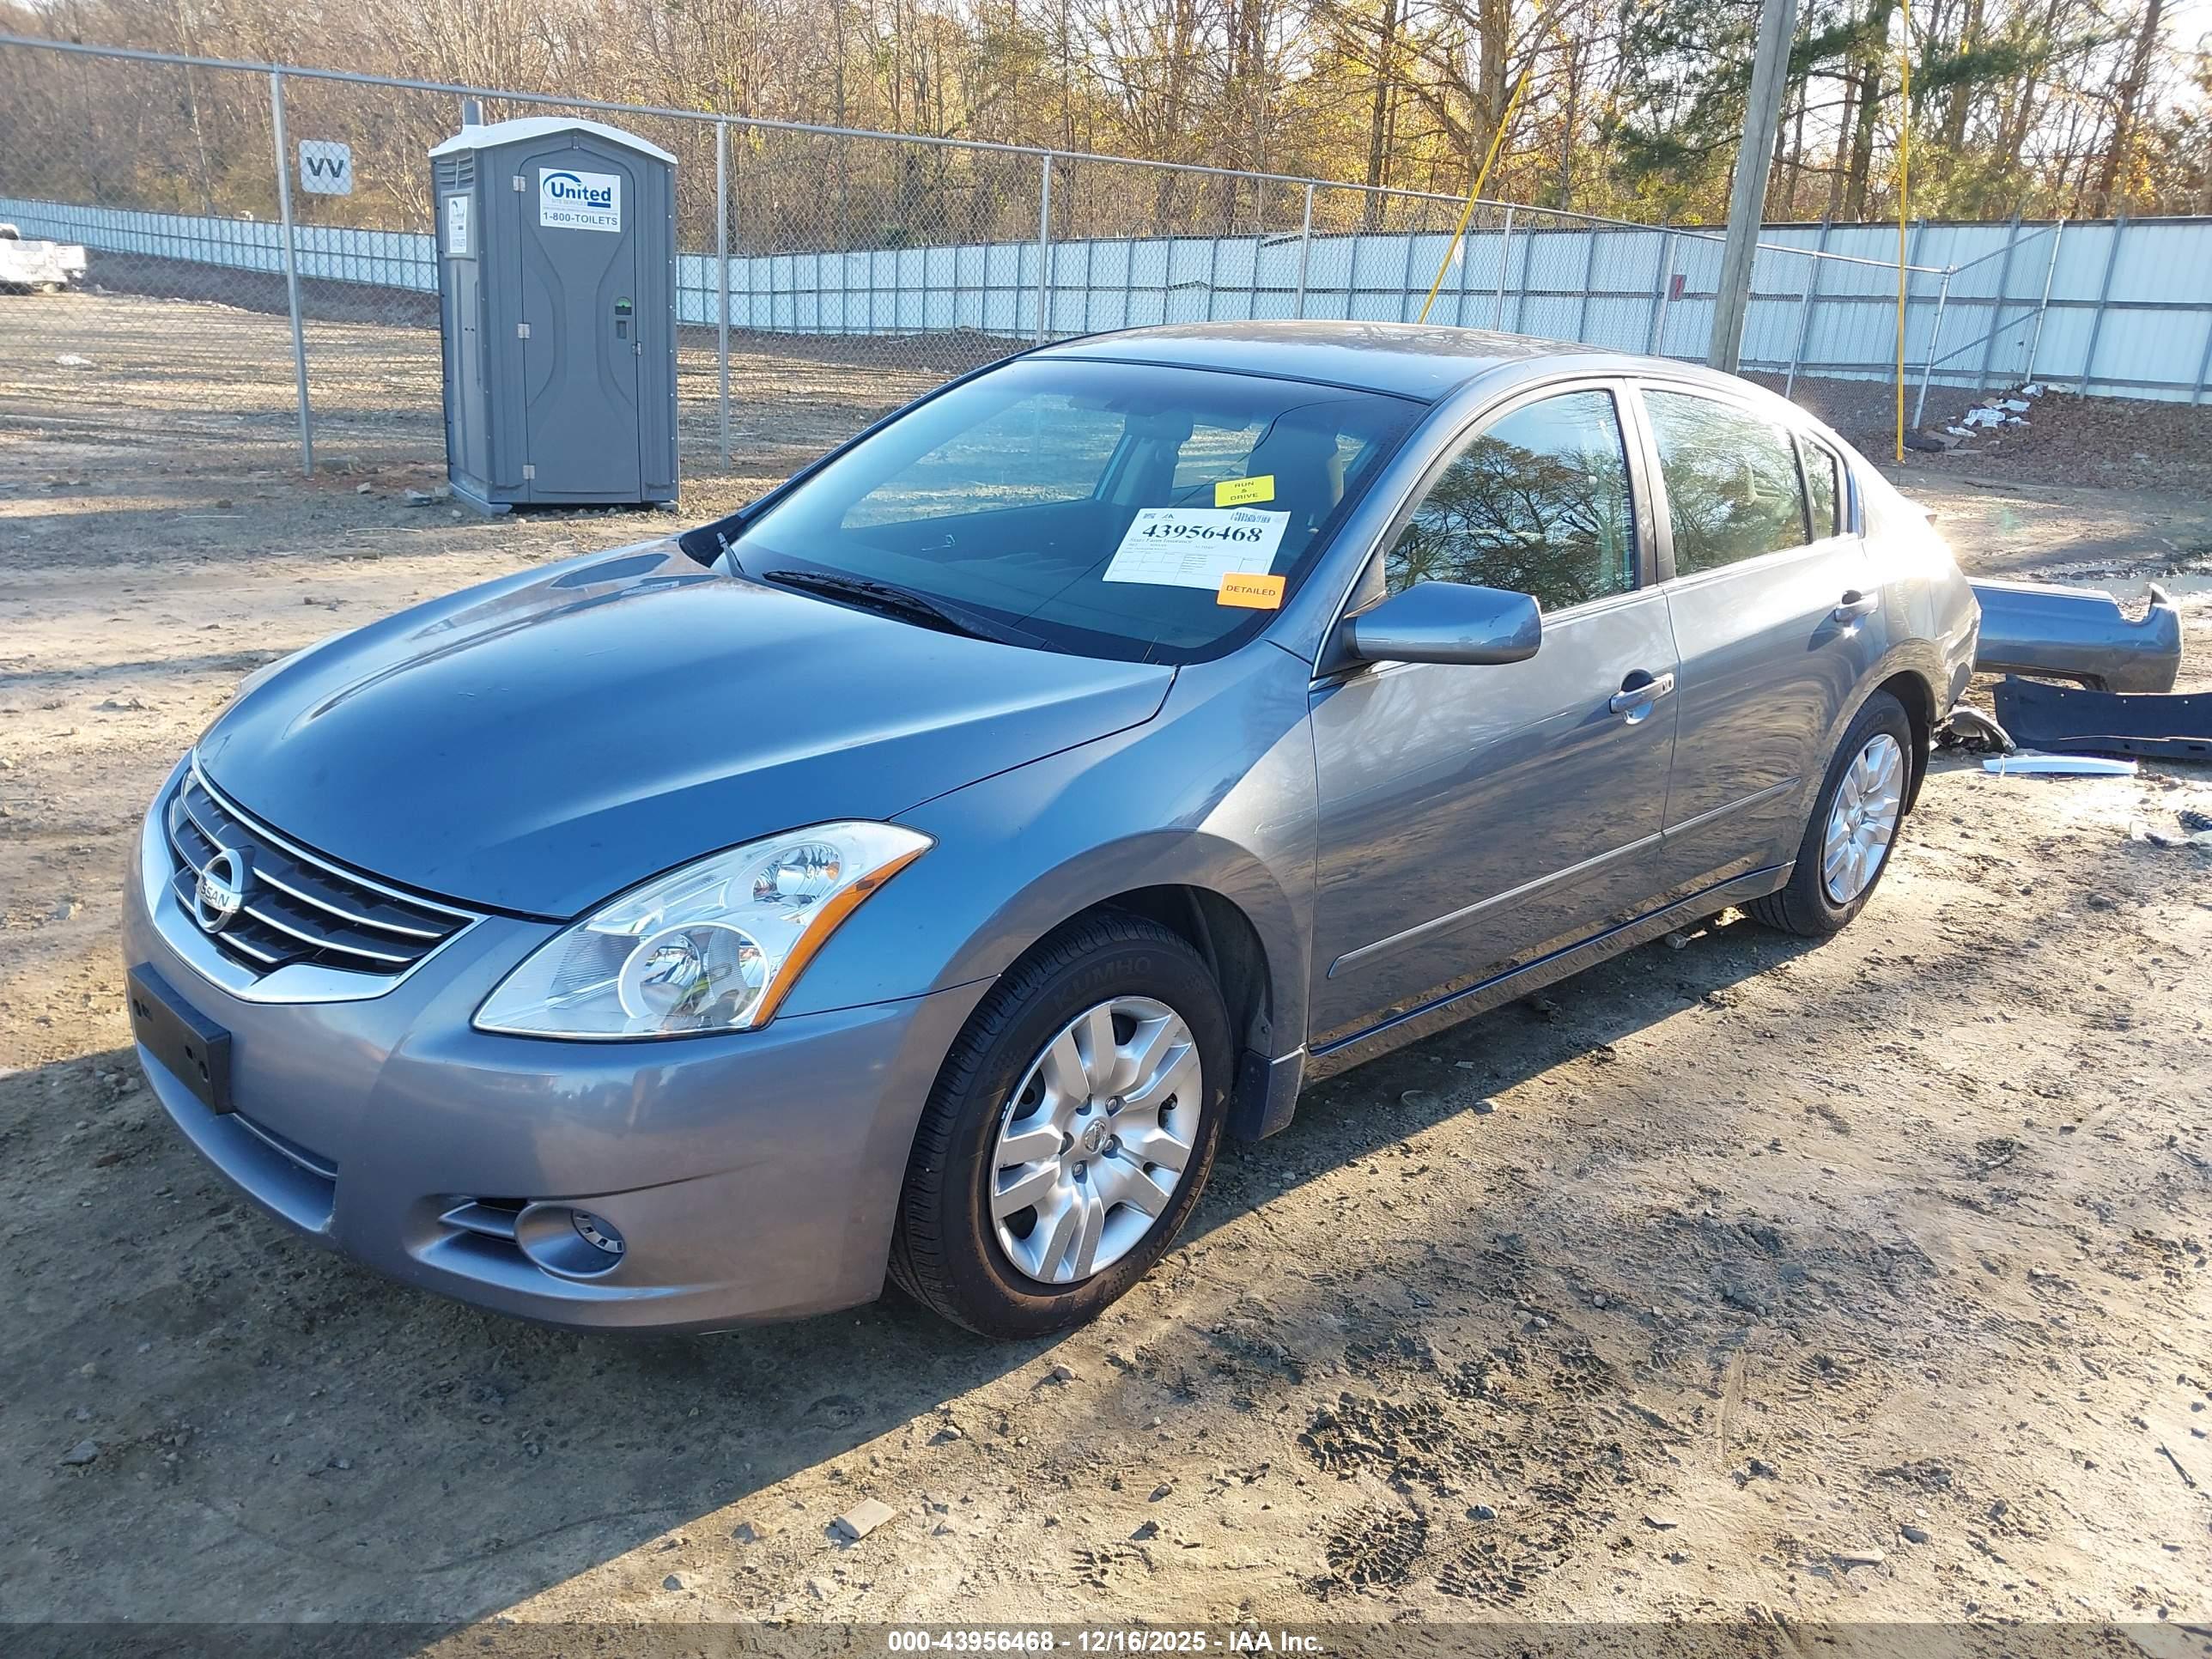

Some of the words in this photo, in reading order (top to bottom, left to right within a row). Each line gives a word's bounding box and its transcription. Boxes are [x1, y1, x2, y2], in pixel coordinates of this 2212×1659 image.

[550, 181, 611, 202] United
[543, 212, 617, 226] 1-800-TOILETS
[1142, 524, 1263, 543] 43956468
[1226, 585, 1276, 596] DETAILED
